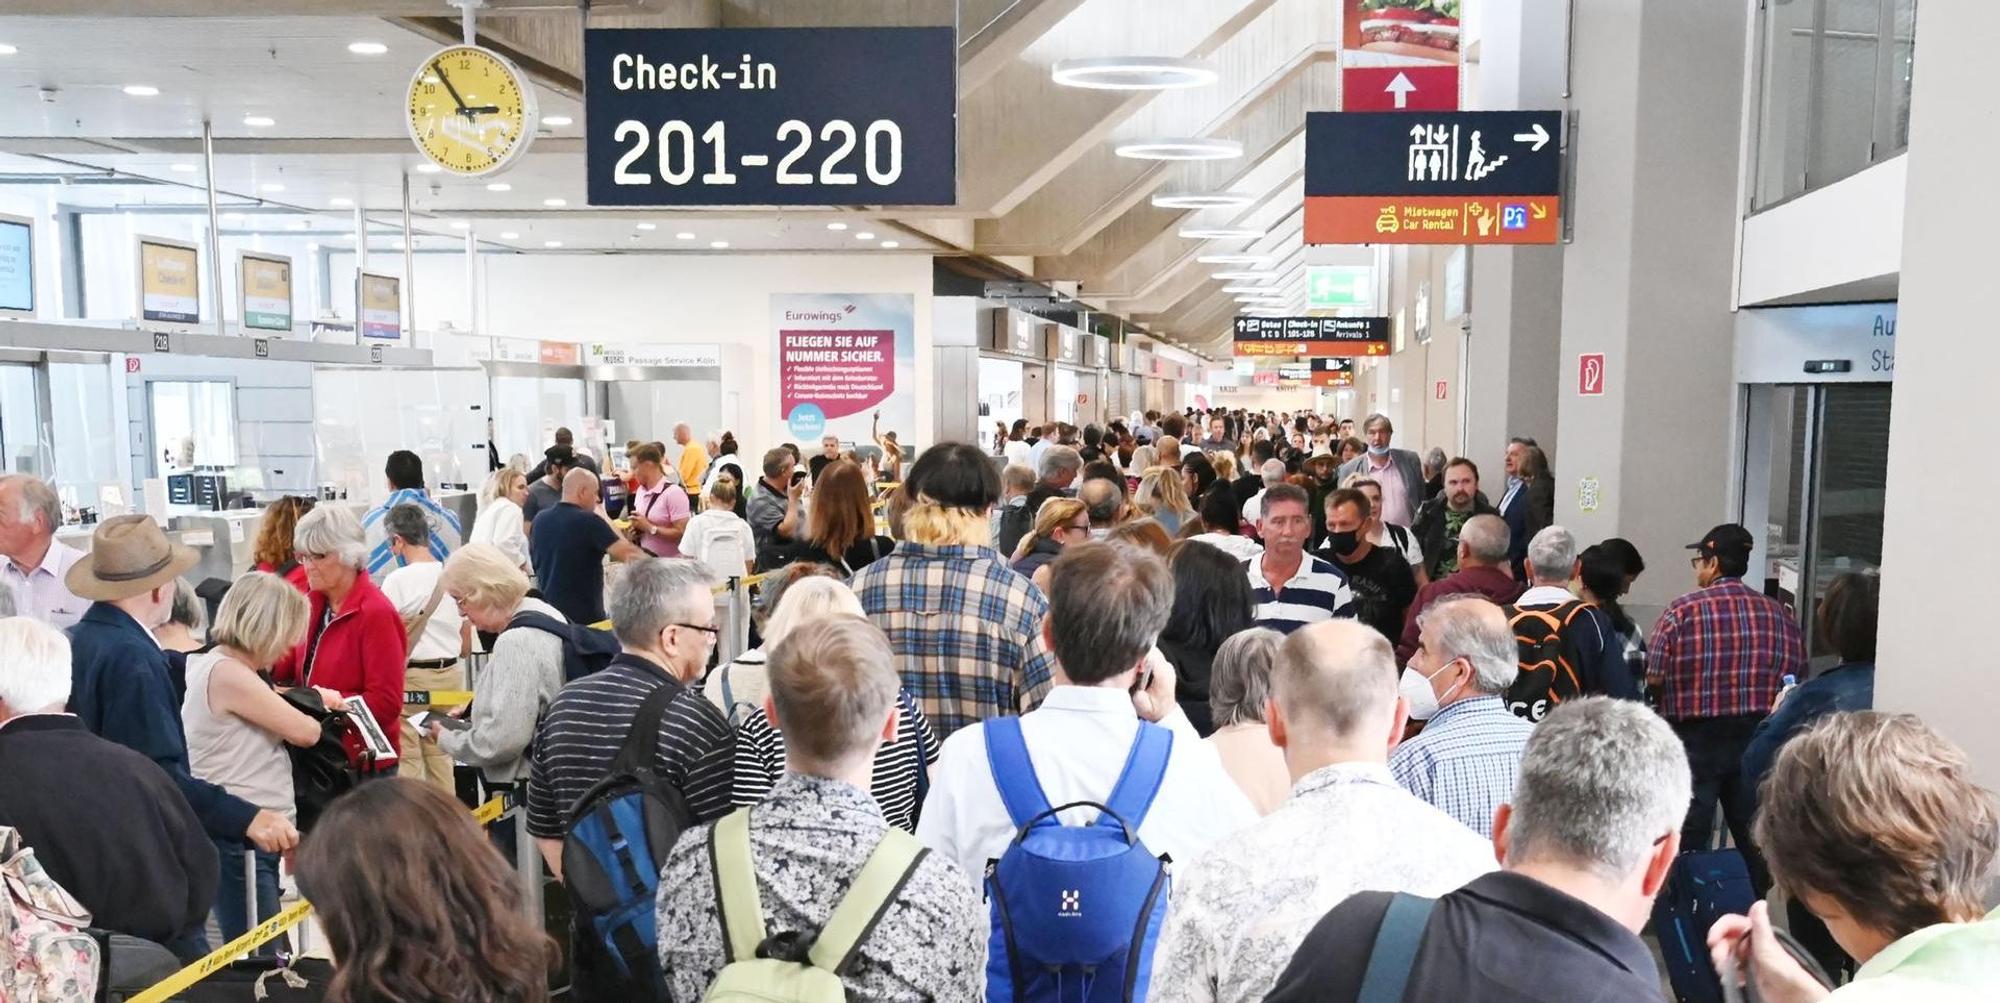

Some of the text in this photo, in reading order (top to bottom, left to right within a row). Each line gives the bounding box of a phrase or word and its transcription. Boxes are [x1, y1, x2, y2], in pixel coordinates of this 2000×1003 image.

[460, 60, 470, 70] 12
[613, 53, 777, 90] Check-in
[424, 85, 435, 94] 10
[499, 85, 506, 94] 2
[420, 107, 426, 116] 9
[466, 153, 472, 163] 6
[613, 119, 902, 186] 201-220
[1404, 207, 1458, 218] Mietwagen
[1403, 219, 1454, 230] Car Rental
[785, 310, 842, 323] Eurowings
[1287, 320, 1318, 328] Check-in
[786, 336, 878, 347] FLIEGEN SIE AUF
[786, 351, 884, 362] NUMMER SICHER.
